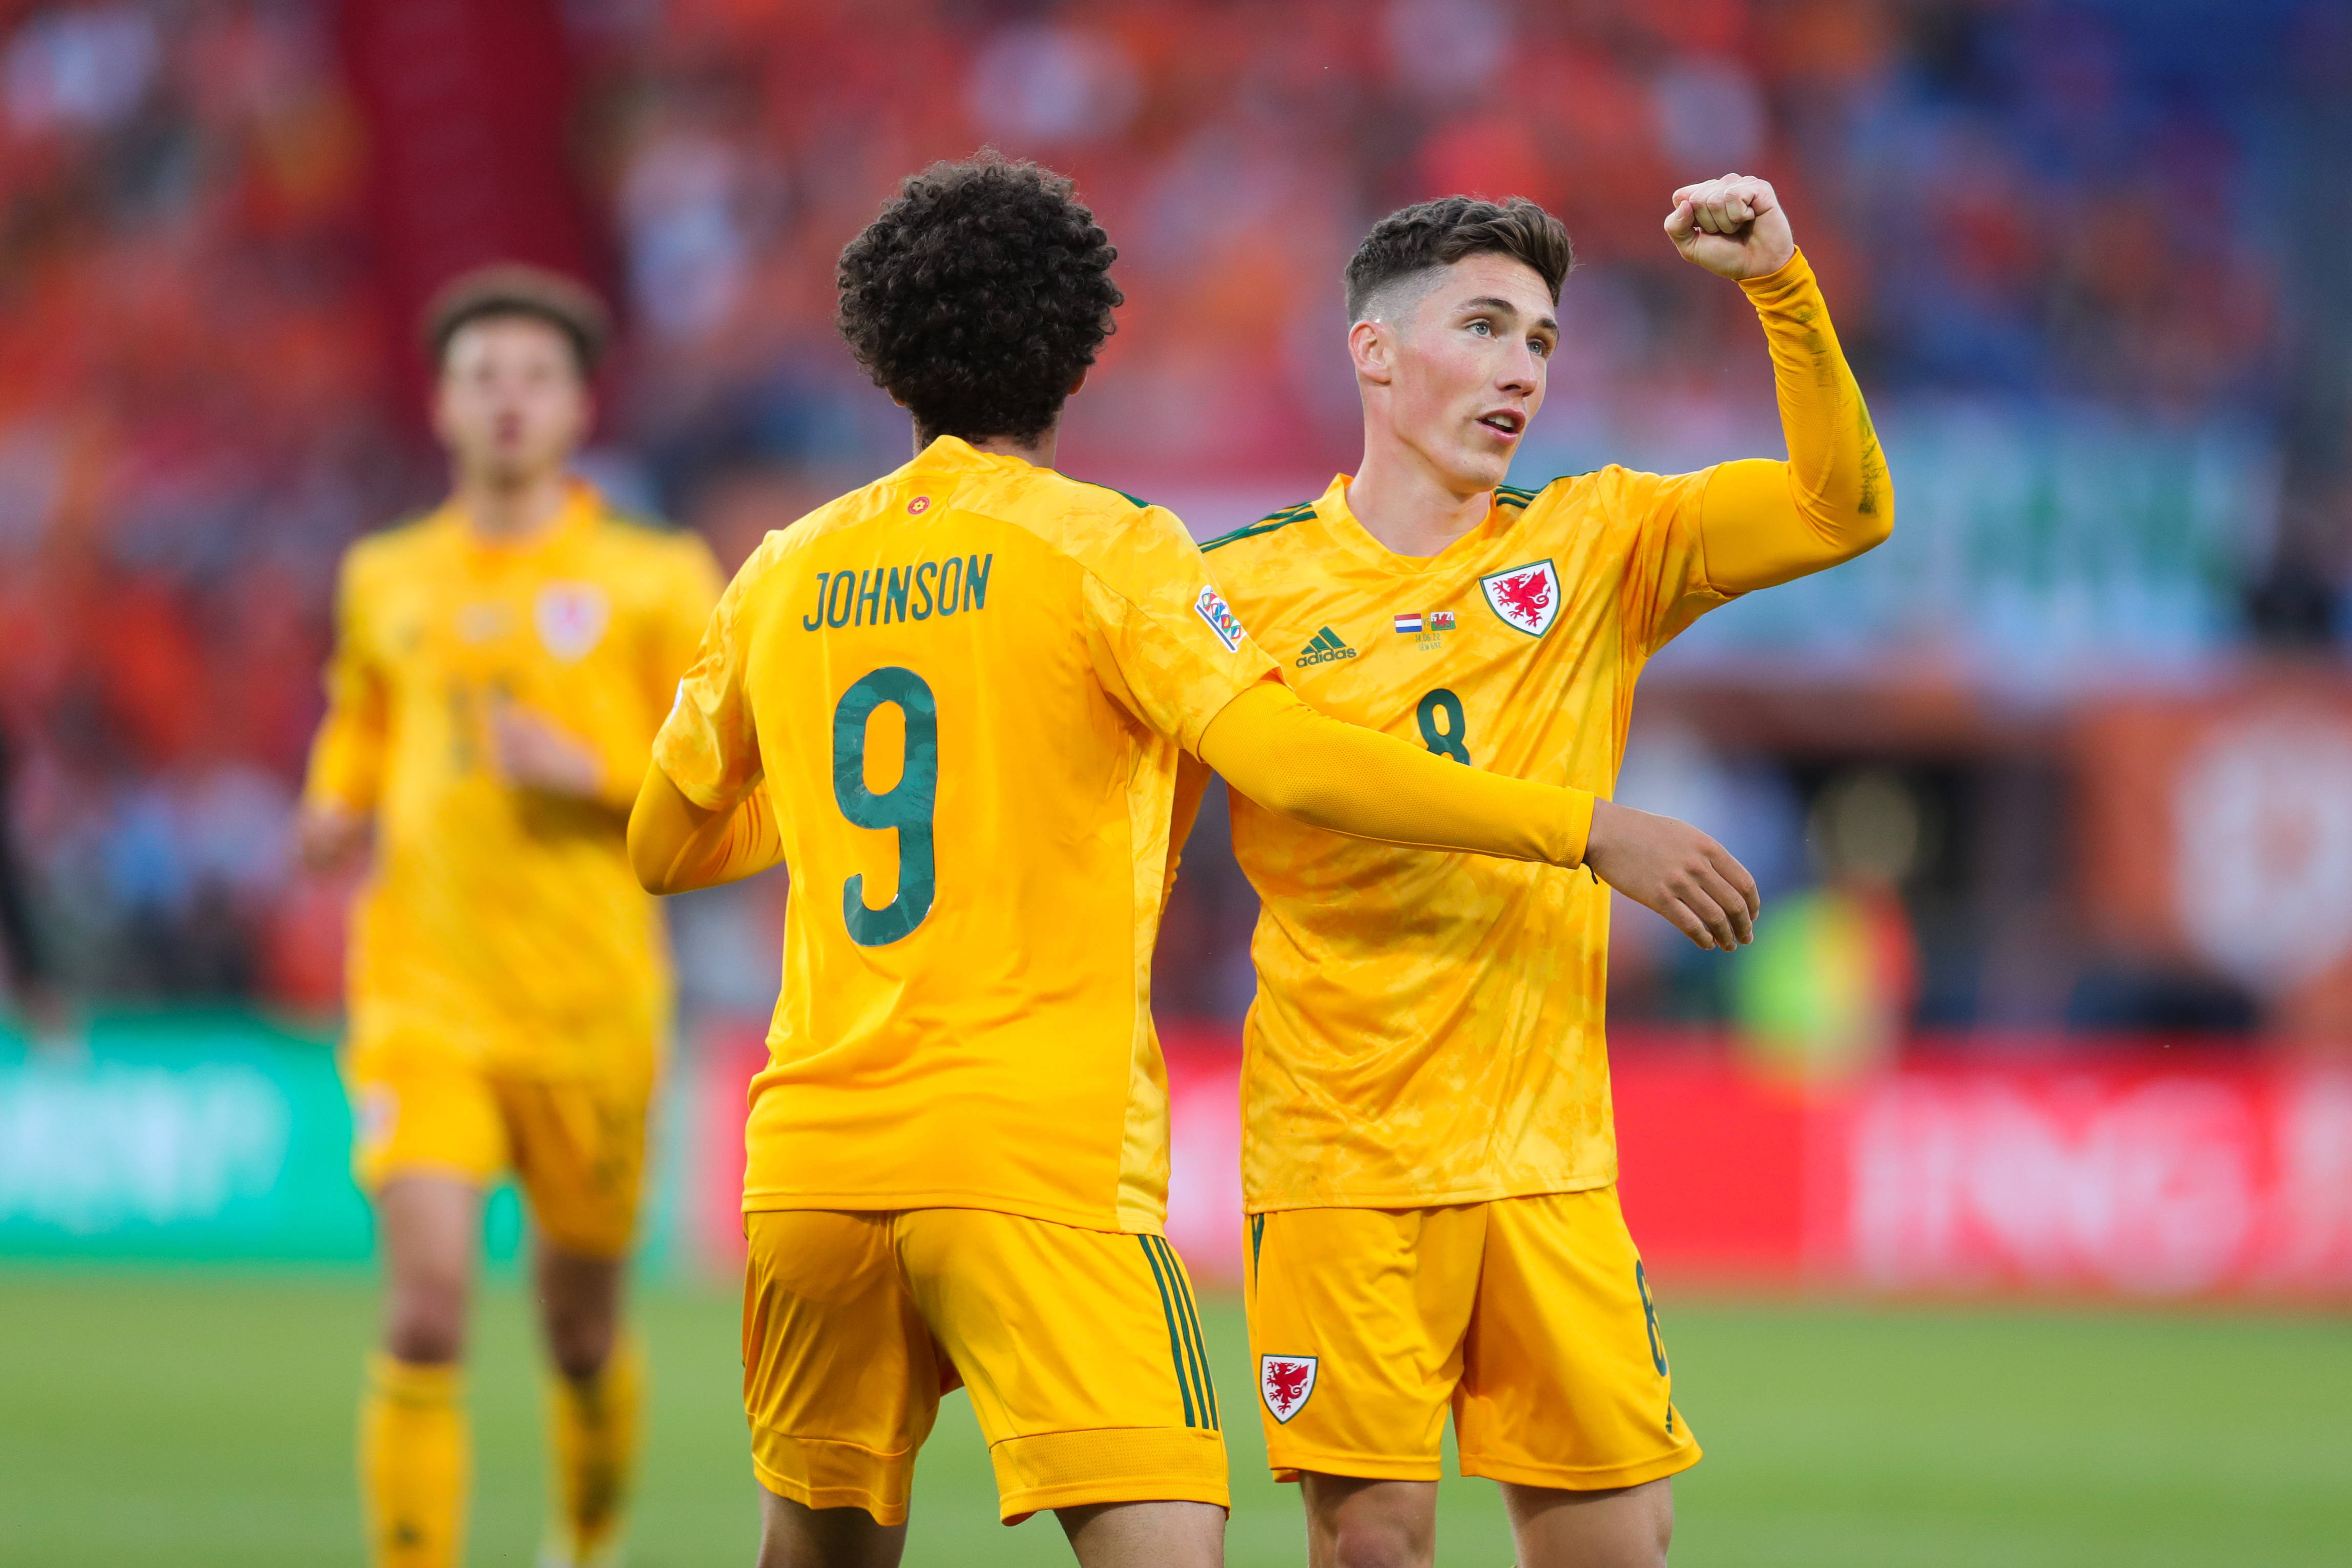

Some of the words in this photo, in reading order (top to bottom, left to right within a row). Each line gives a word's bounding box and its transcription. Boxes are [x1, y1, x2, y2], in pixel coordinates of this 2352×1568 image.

[803, 553, 993, 632] JOHNSON
[1295, 647, 1357, 668] adidas
[1417, 688, 1471, 766] 8
[833, 666, 938, 947] 9
